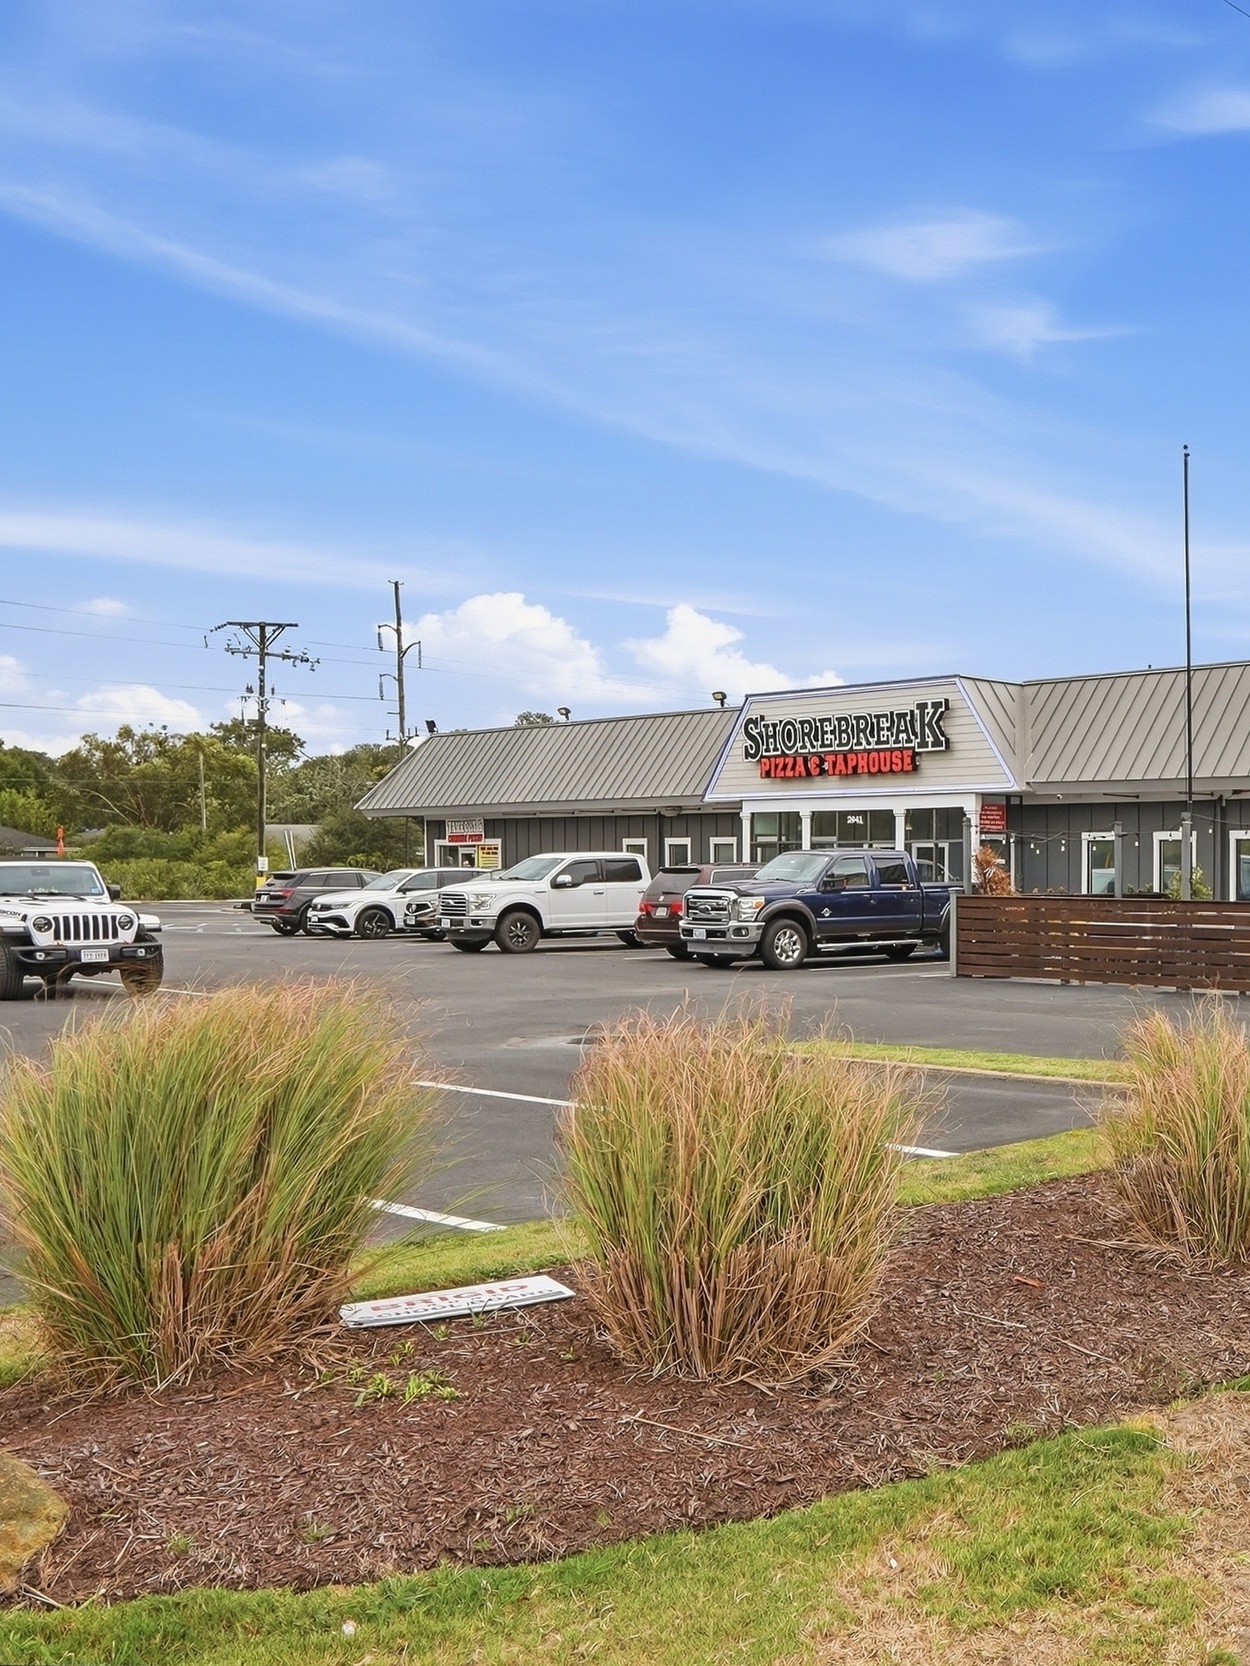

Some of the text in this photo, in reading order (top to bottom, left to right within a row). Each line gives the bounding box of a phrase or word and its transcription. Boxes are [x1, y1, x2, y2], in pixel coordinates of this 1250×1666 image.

[743, 699, 949, 762] SHOREBREAK
[760, 756, 806, 778] PIZZA
[825, 750, 914, 775] TAPHOUSE
